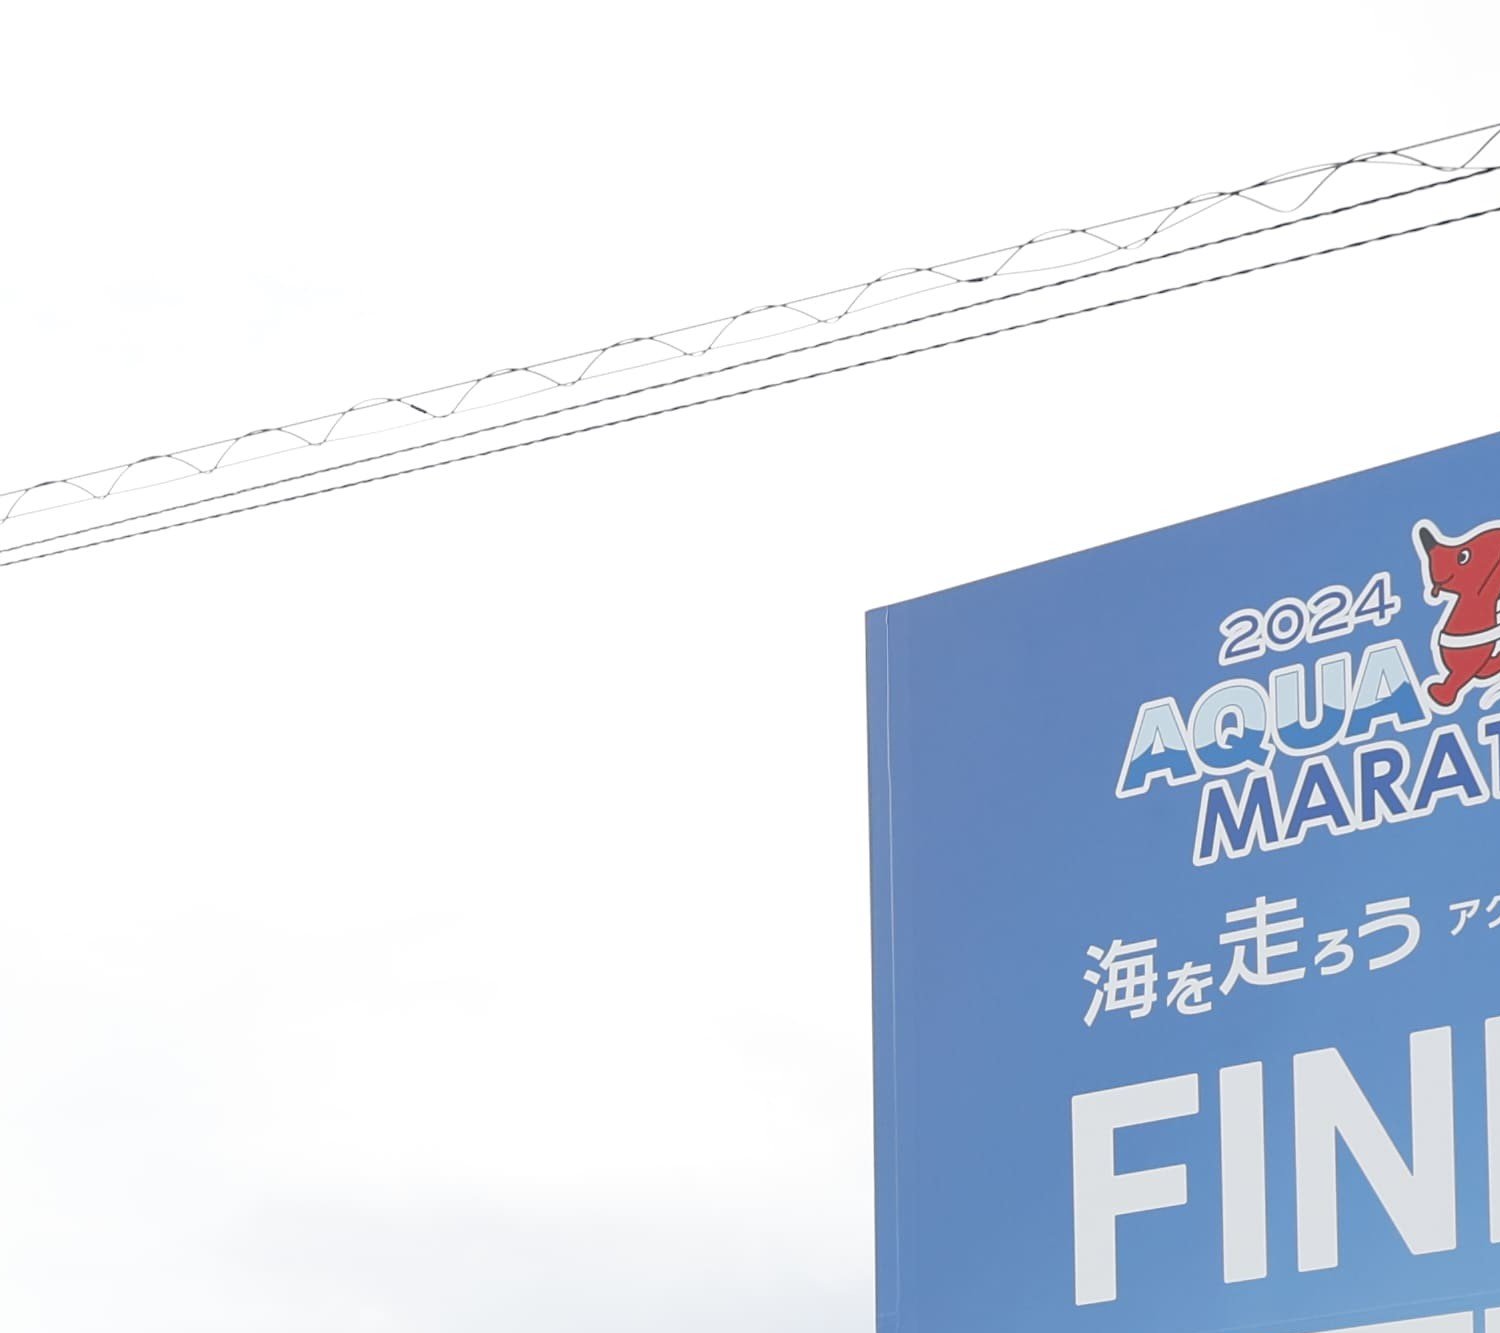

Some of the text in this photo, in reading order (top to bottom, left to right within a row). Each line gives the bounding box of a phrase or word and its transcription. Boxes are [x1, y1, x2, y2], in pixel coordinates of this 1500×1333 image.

[1218, 575, 1399, 666] 2024
[1116, 639, 1431, 796] AQUA
[1083, 895, 1422, 1027] 海を走ろう
